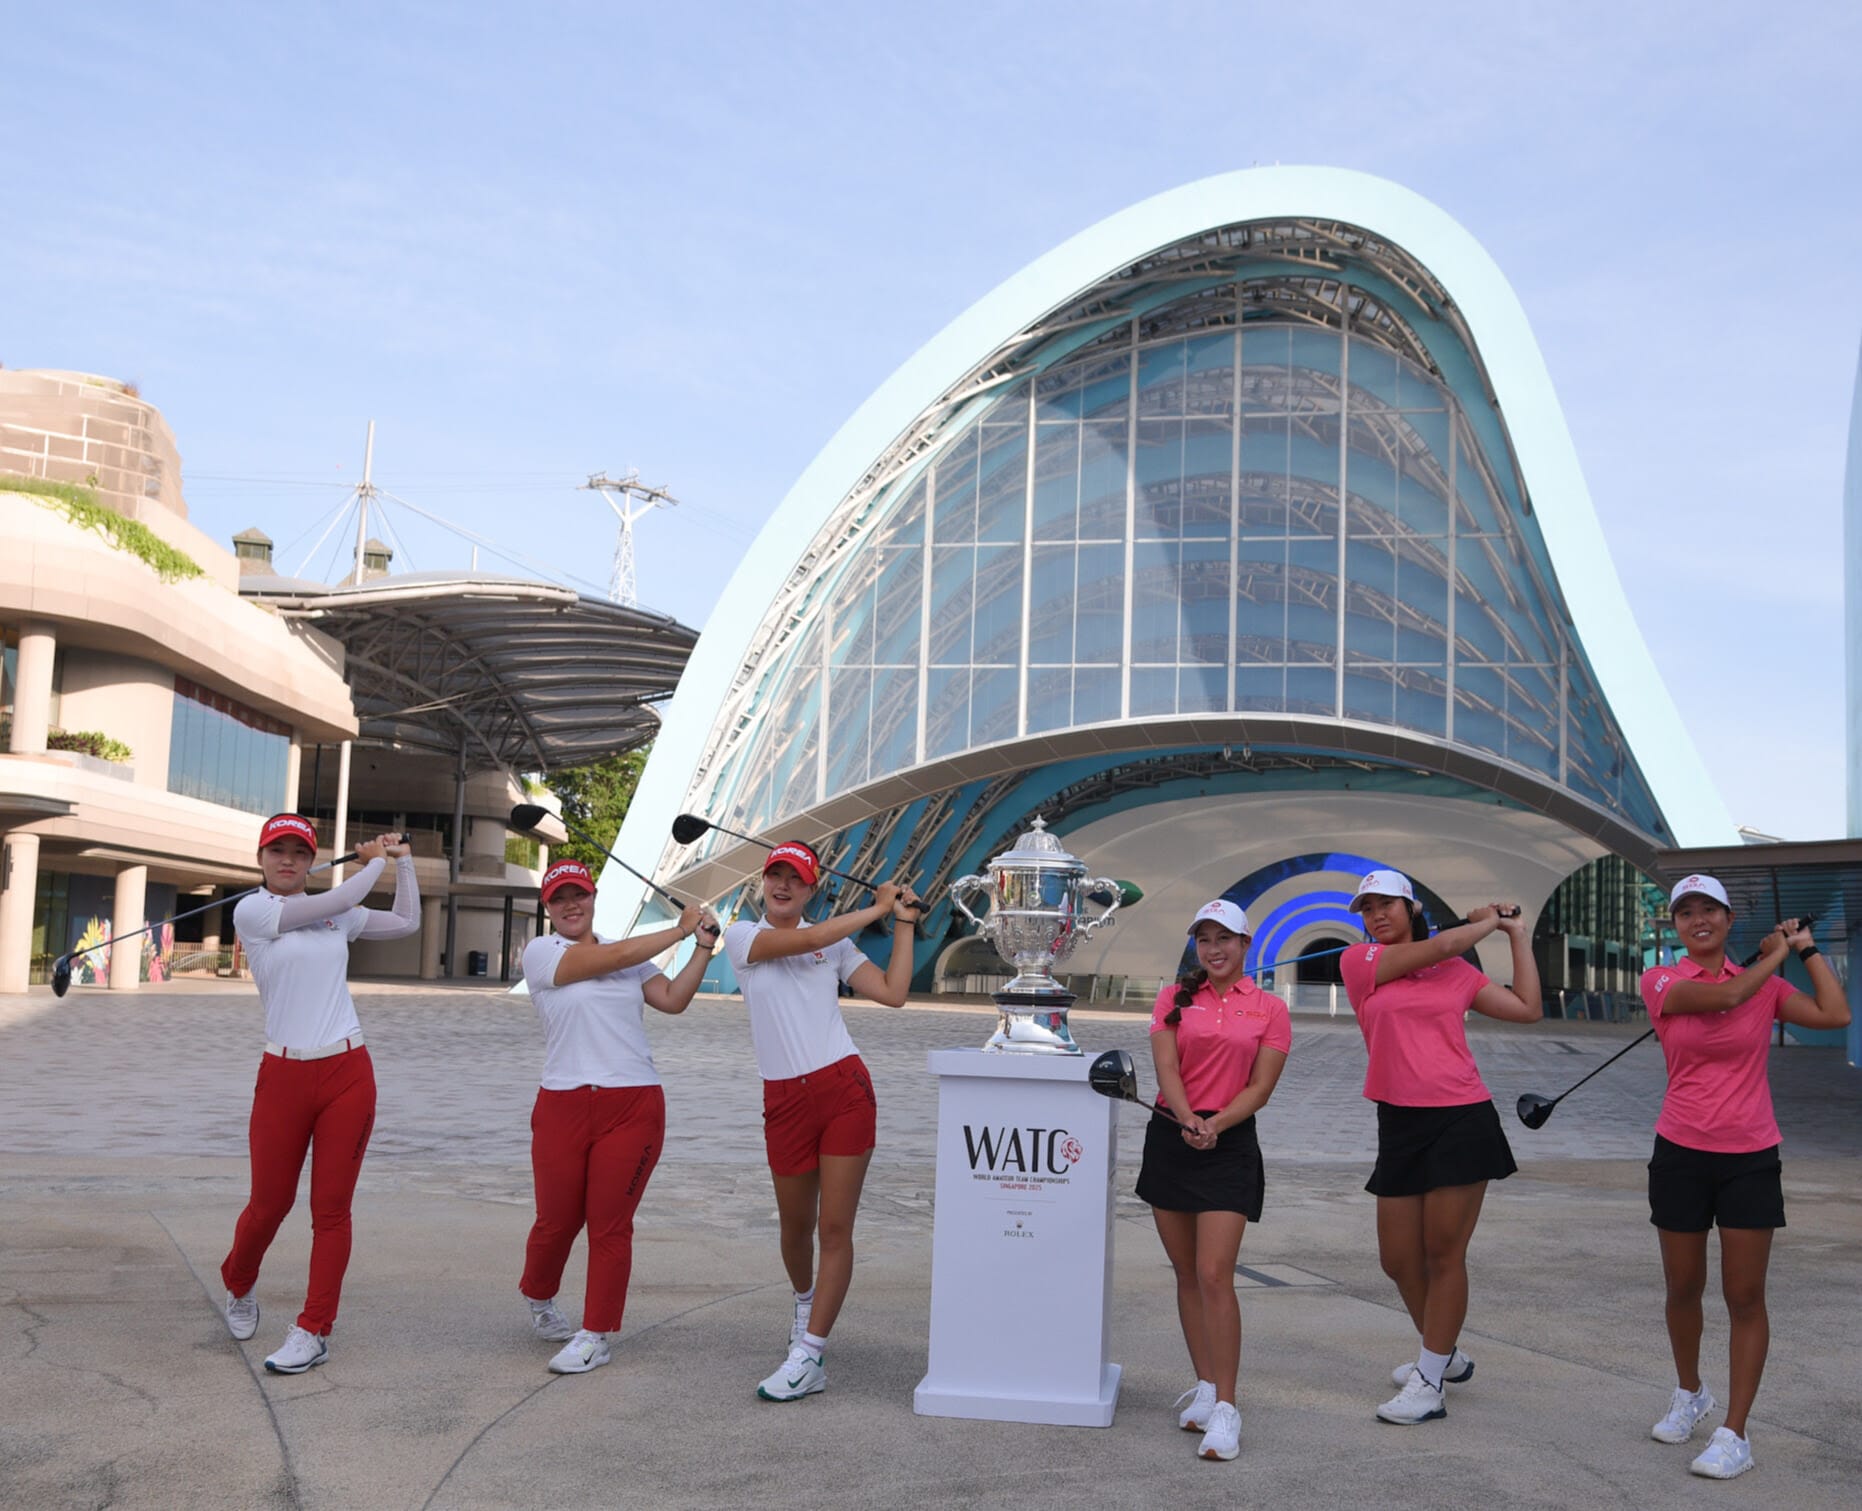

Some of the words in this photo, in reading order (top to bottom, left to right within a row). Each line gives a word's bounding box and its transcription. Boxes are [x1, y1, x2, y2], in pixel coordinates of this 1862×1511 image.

[269, 819, 312, 837] KOREA
[544, 865, 588, 884] KOREA
[963, 1125, 1069, 1174] WATC
[1029, 1176, 1070, 1185] CHAMPIONSHIPS
[1004, 1230, 1034, 1238] ROLEX
